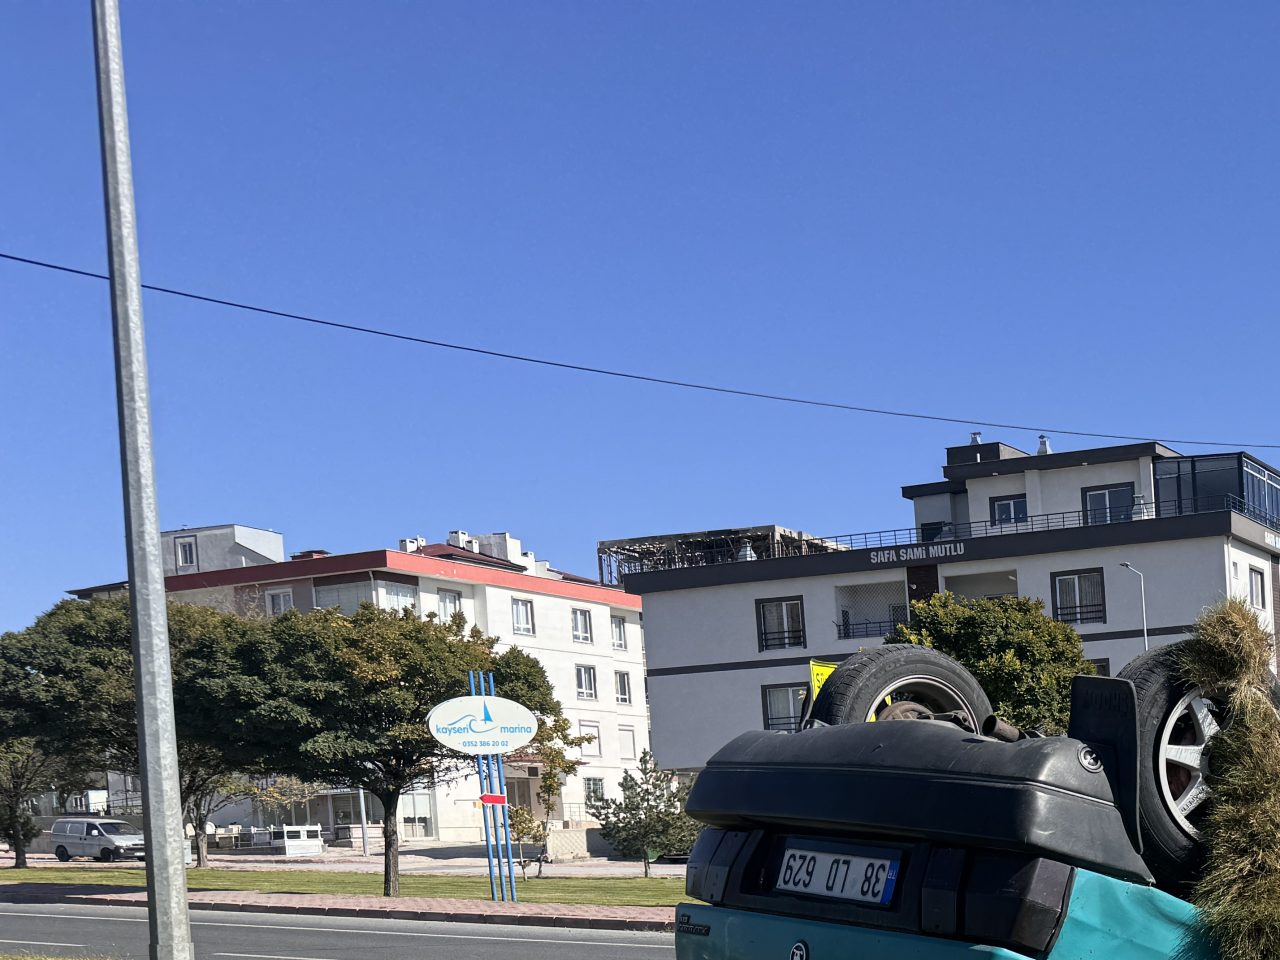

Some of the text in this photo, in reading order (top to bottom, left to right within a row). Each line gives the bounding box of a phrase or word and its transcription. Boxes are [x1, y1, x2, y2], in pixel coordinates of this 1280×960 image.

[870, 550, 897, 563] SAFA
[929, 542, 965, 558] MUTLU
[435, 724, 532, 736] kayseri marina
[782, 853, 897, 897] TR 38 LD 629
